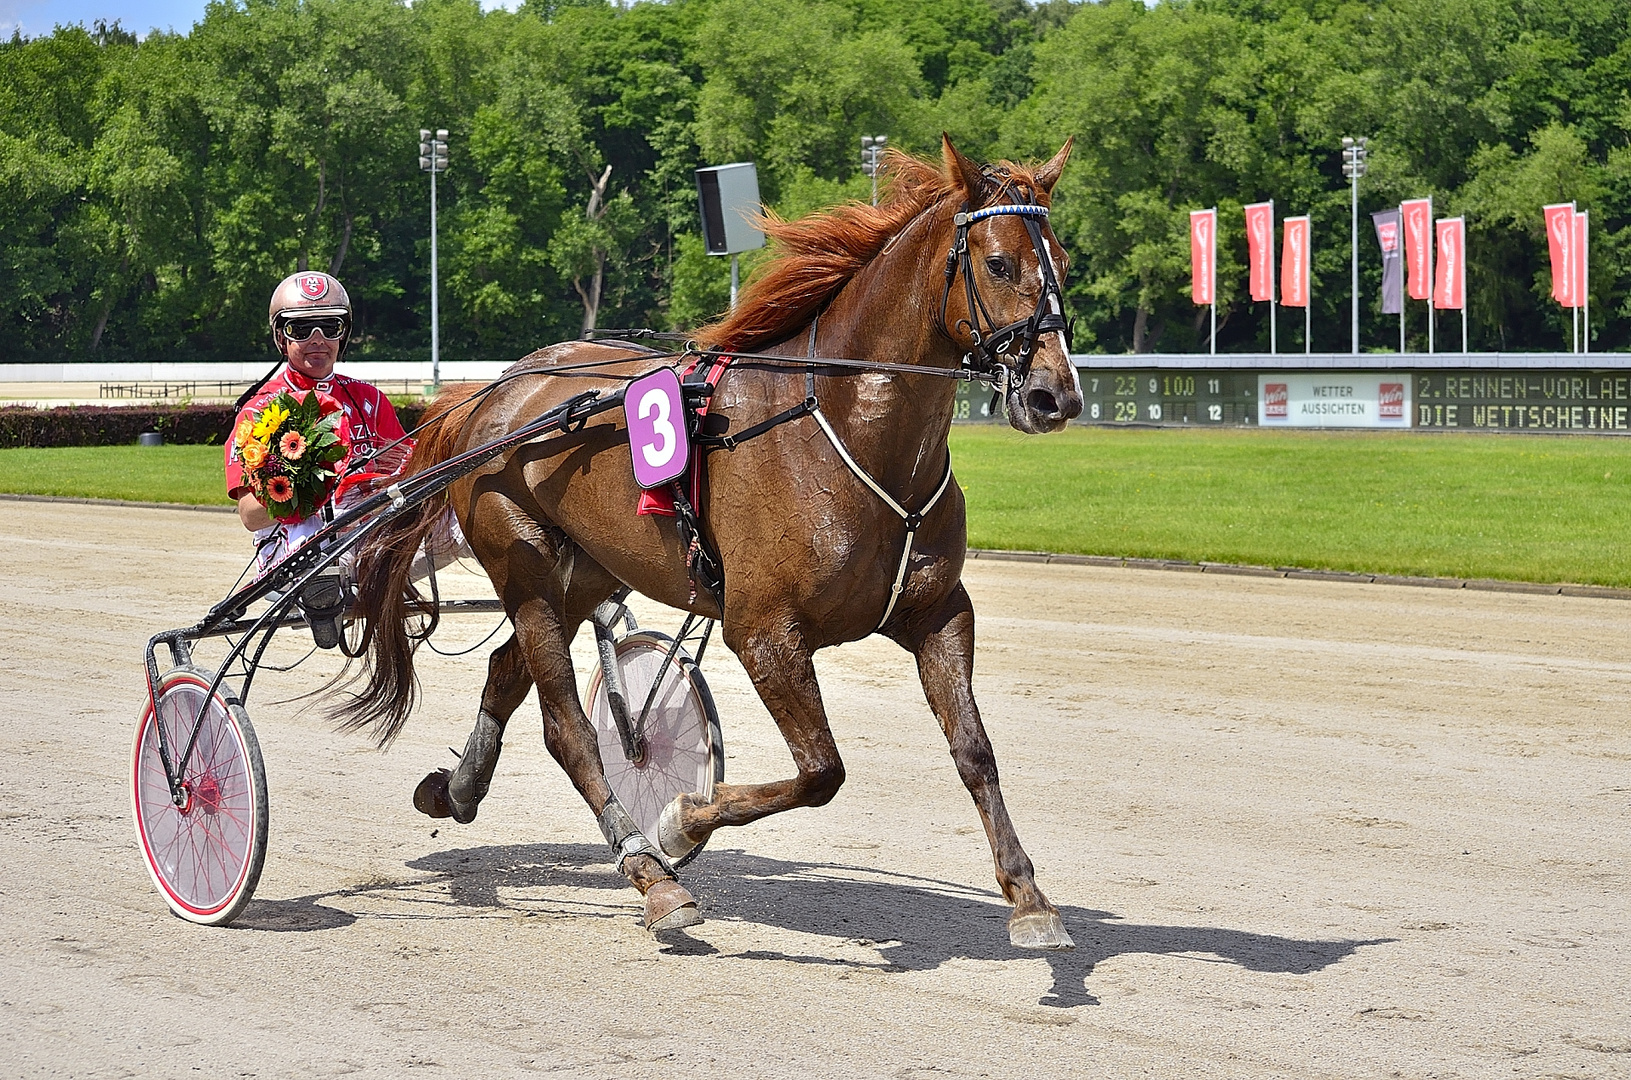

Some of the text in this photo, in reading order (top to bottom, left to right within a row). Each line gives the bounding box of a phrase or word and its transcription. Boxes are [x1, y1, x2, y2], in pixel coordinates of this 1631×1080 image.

[1091, 378, 1099, 393] 7
[1149, 378, 1157, 393] 9
[1208, 379, 1219, 394] 11
[1312, 386, 1353, 397] WETTER
[1419, 377, 1631, 399] 2.RENNEN-VORLAE
[1265, 386, 1287, 403] Win
[1380, 386, 1403, 404] Win
[980, 402, 989, 417] 4
[1091, 403, 1100, 418] 8
[1148, 404, 1162, 420] 10
[1208, 404, 1222, 421] 12
[1301, 403, 1365, 415] AUSSICHTEN
[1419, 405, 1628, 429] DIE WETTSCHEINE
[638, 388, 677, 468] 3
